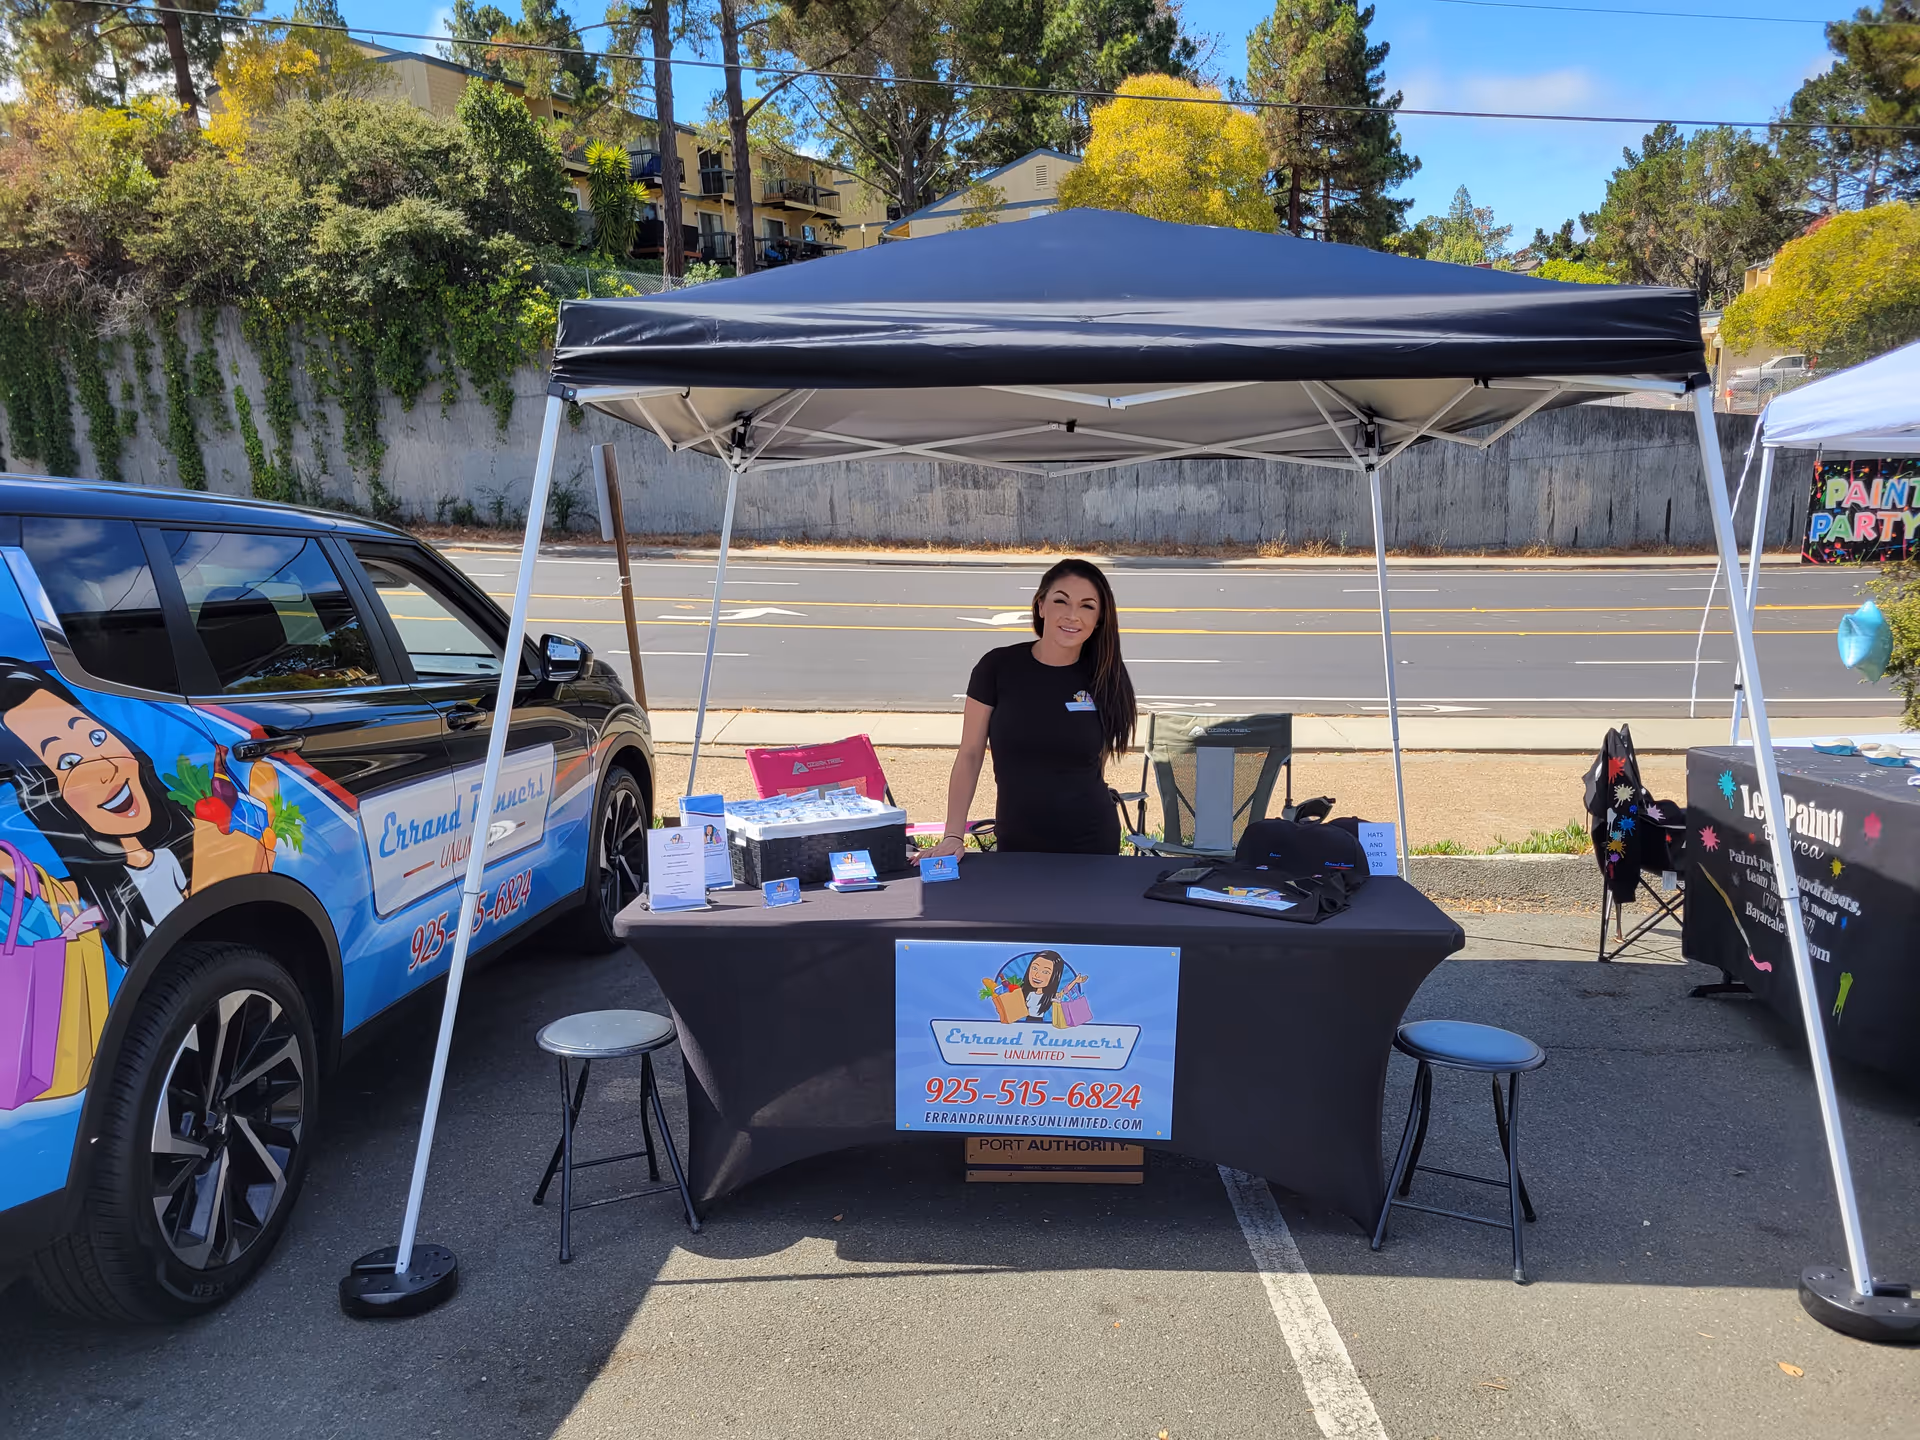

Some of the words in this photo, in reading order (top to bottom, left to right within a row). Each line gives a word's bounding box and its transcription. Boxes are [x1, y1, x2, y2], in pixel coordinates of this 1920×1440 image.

[1809, 511, 1920, 543] PARTY
[379, 793, 462, 858] Errand
[1783, 793, 1843, 848] Paint!
[1728, 849, 1758, 867] Paint
[1789, 832, 1824, 860] rea
[409, 868, 532, 970] 925-5-6824
[945, 1028, 1023, 1046] Errand
[1031, 1030, 1125, 1049] Runners
[1003, 1049, 1066, 1061] UNLIMITED
[925, 1077, 1142, 1110] 925-515-6824
[924, 1111, 1143, 1131] ERRANDRUNNERSUNLIMITED.COM
[979, 1138, 1025, 1151] PORT
